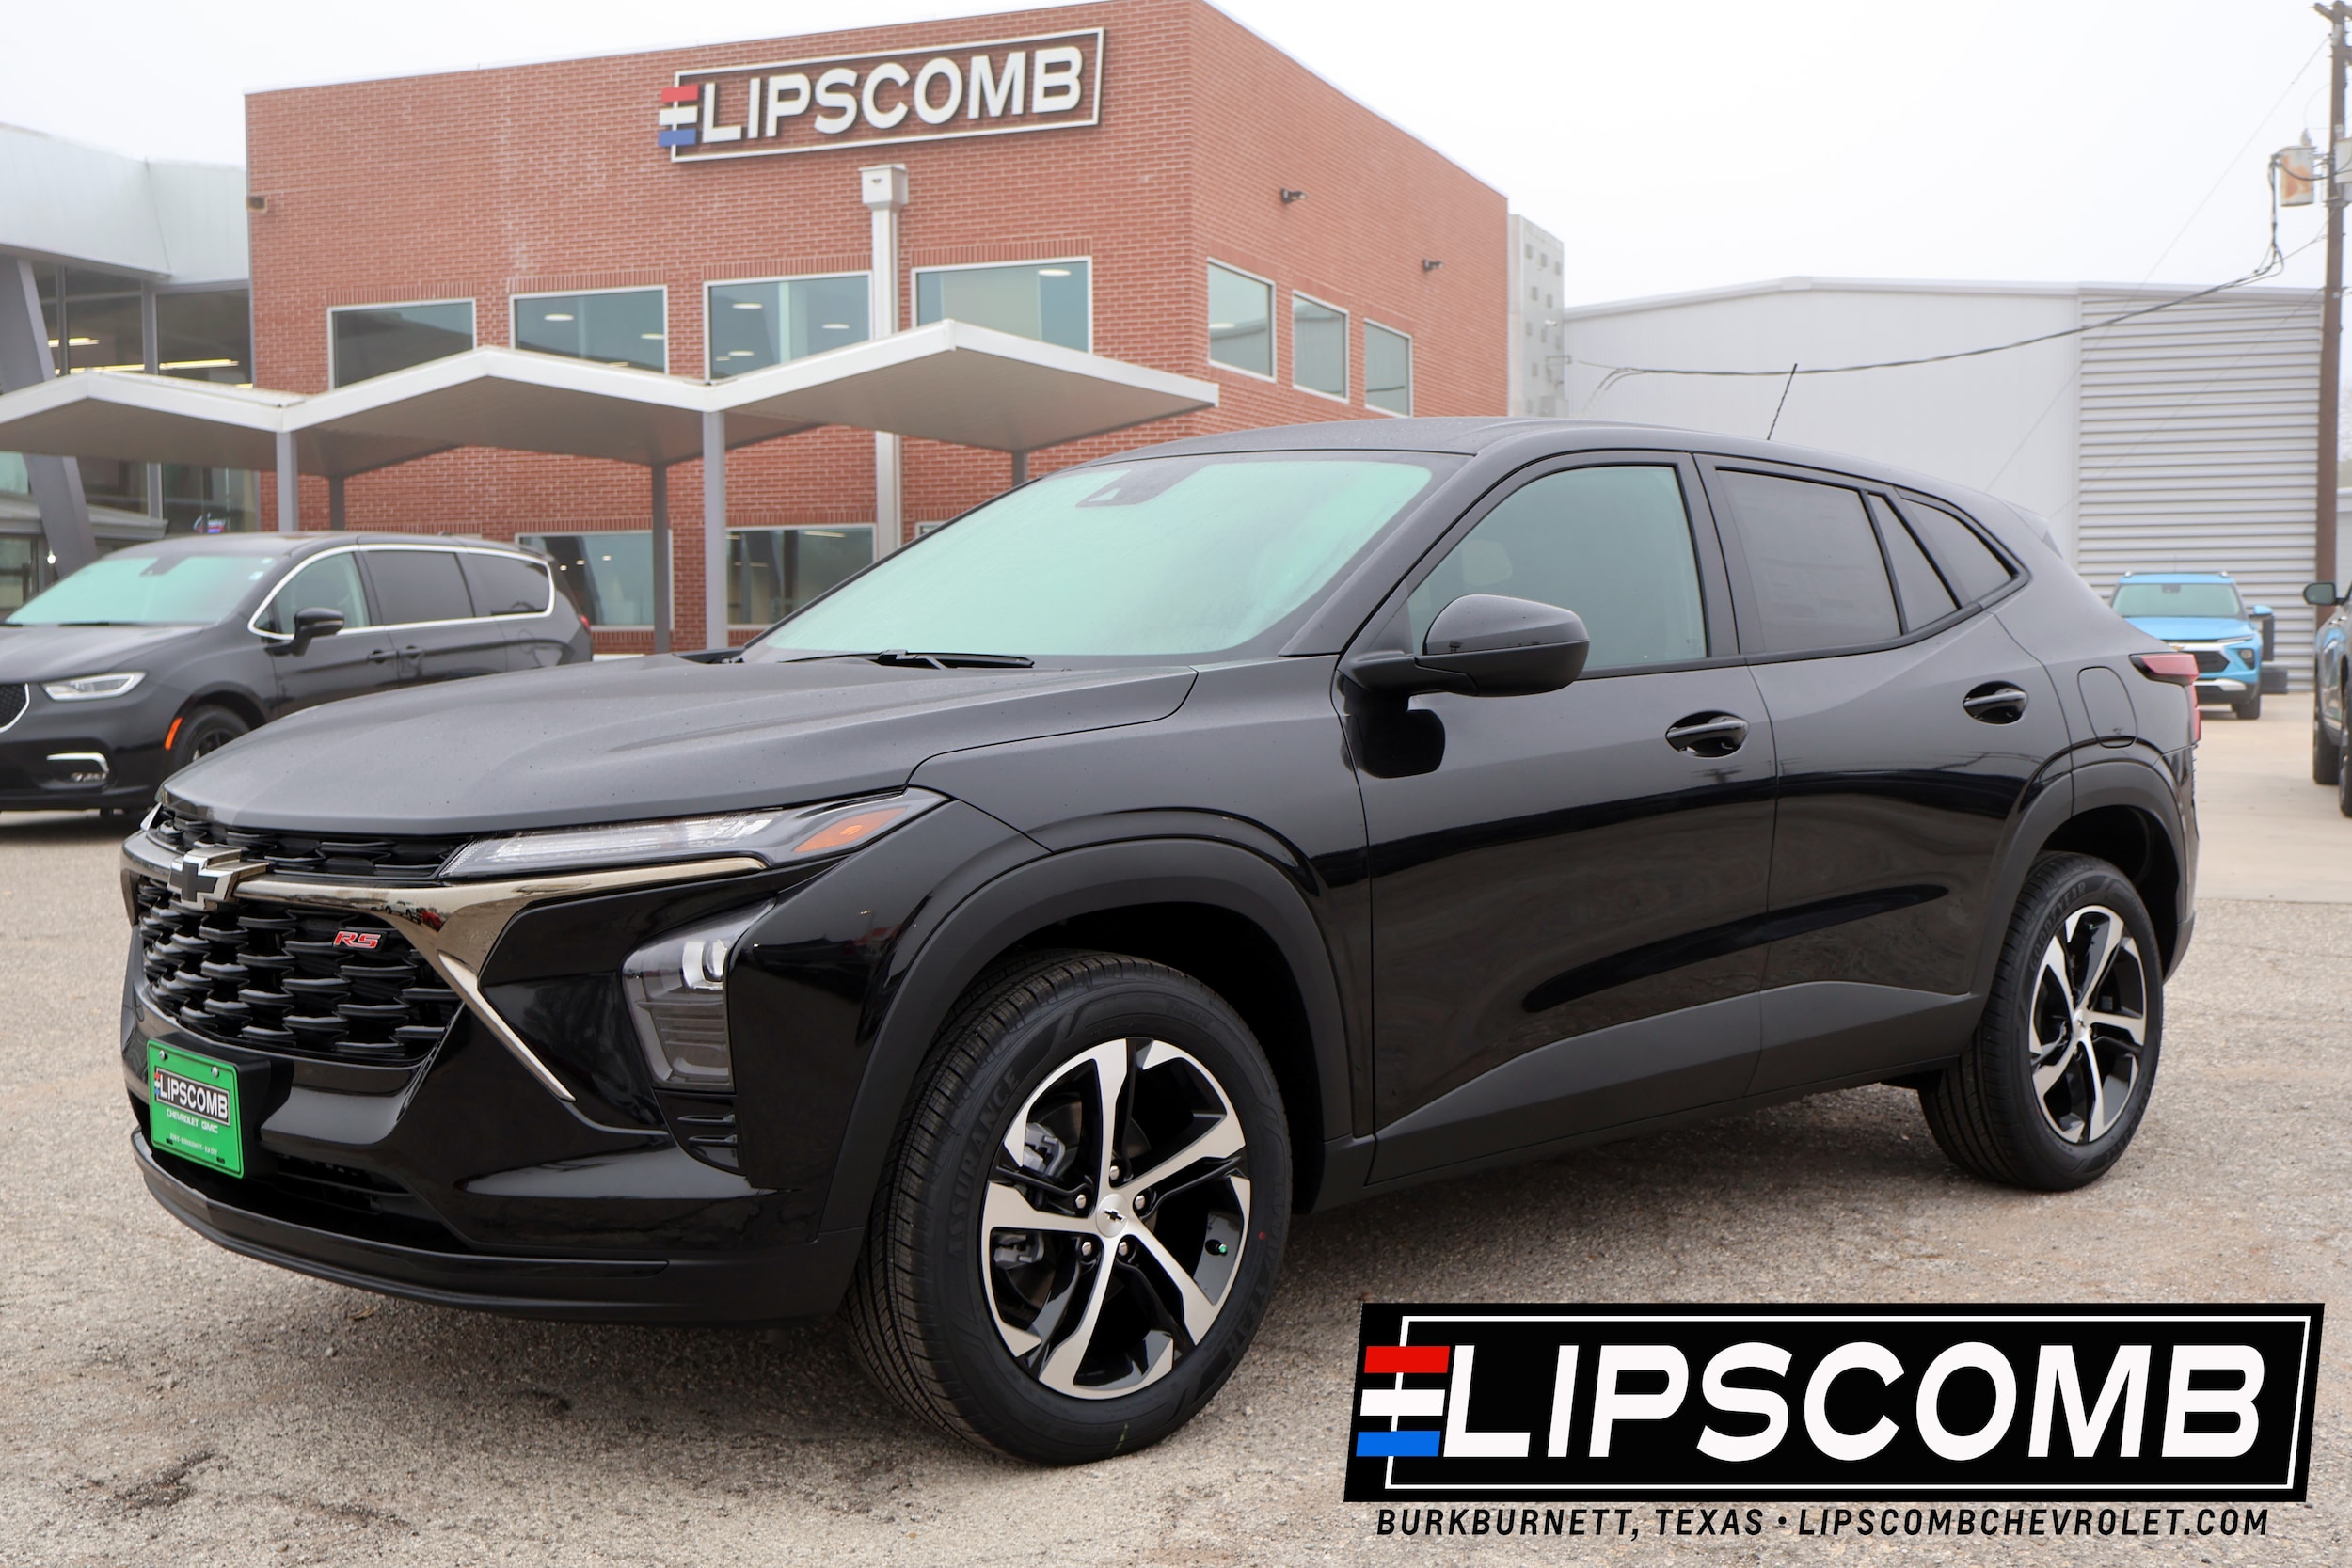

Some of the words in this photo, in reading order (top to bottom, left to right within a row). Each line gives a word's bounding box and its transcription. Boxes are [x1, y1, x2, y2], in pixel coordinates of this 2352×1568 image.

[702, 46, 1083, 143] LIPSCOMB
[333, 930, 381, 949] RS
[159, 1074, 228, 1119] LIPSCOMB
[167, 1108, 199, 1128] CHEVROLET
[201, 1121, 218, 1134] GMC
[947, 1069, 1020, 1261] ASSURANCE
